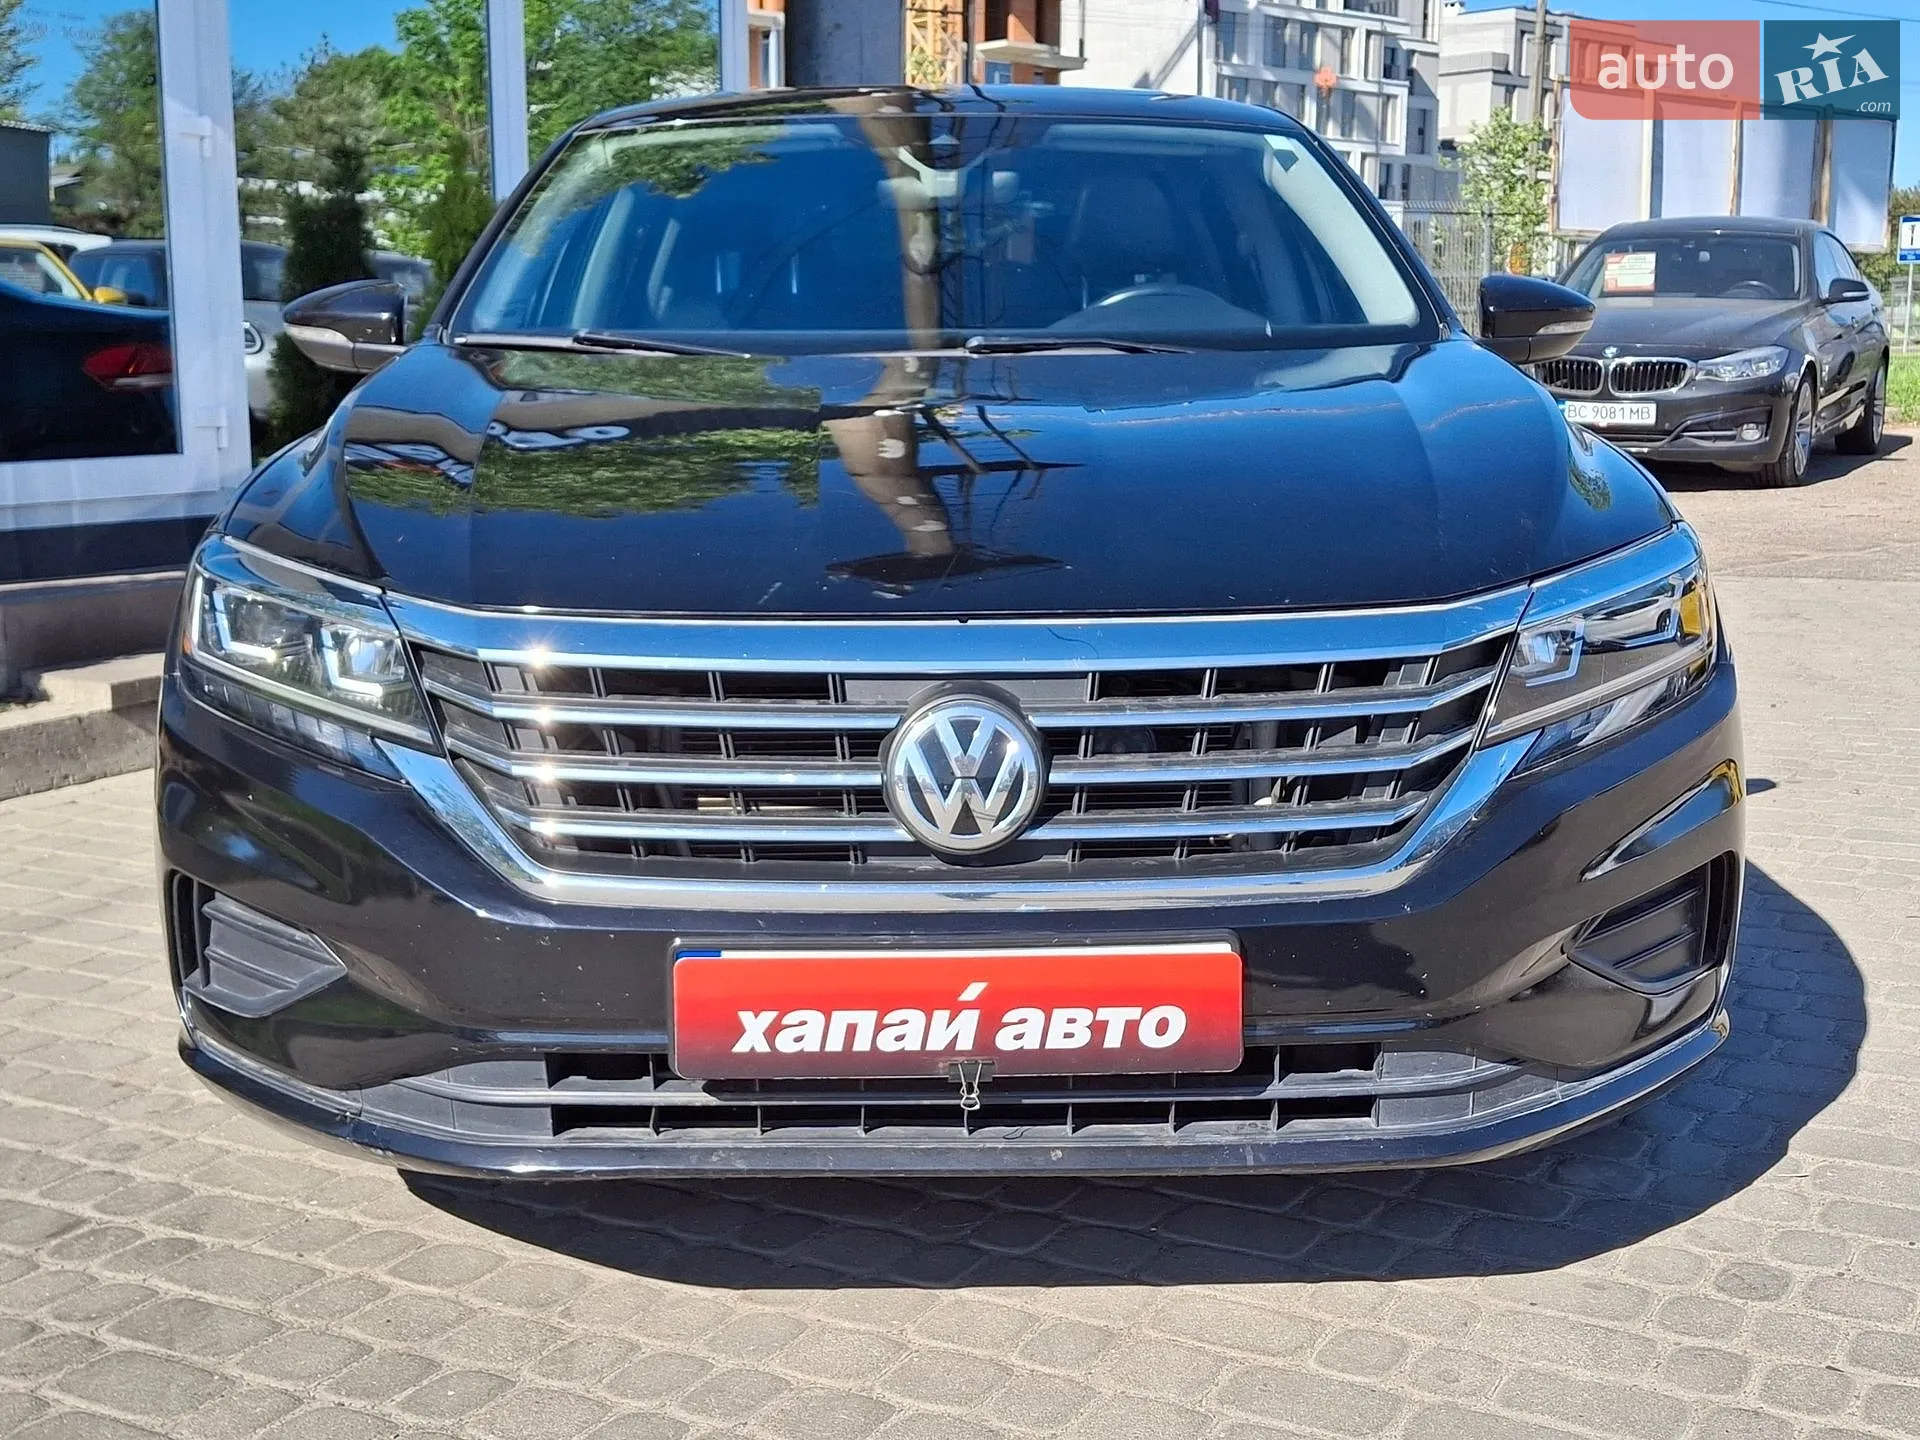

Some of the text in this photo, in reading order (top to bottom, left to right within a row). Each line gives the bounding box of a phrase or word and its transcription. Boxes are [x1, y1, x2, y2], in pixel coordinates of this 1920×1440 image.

[1567, 404, 1651, 420] BC 9081 MB
[731, 982, 1187, 1053] хапай авто
